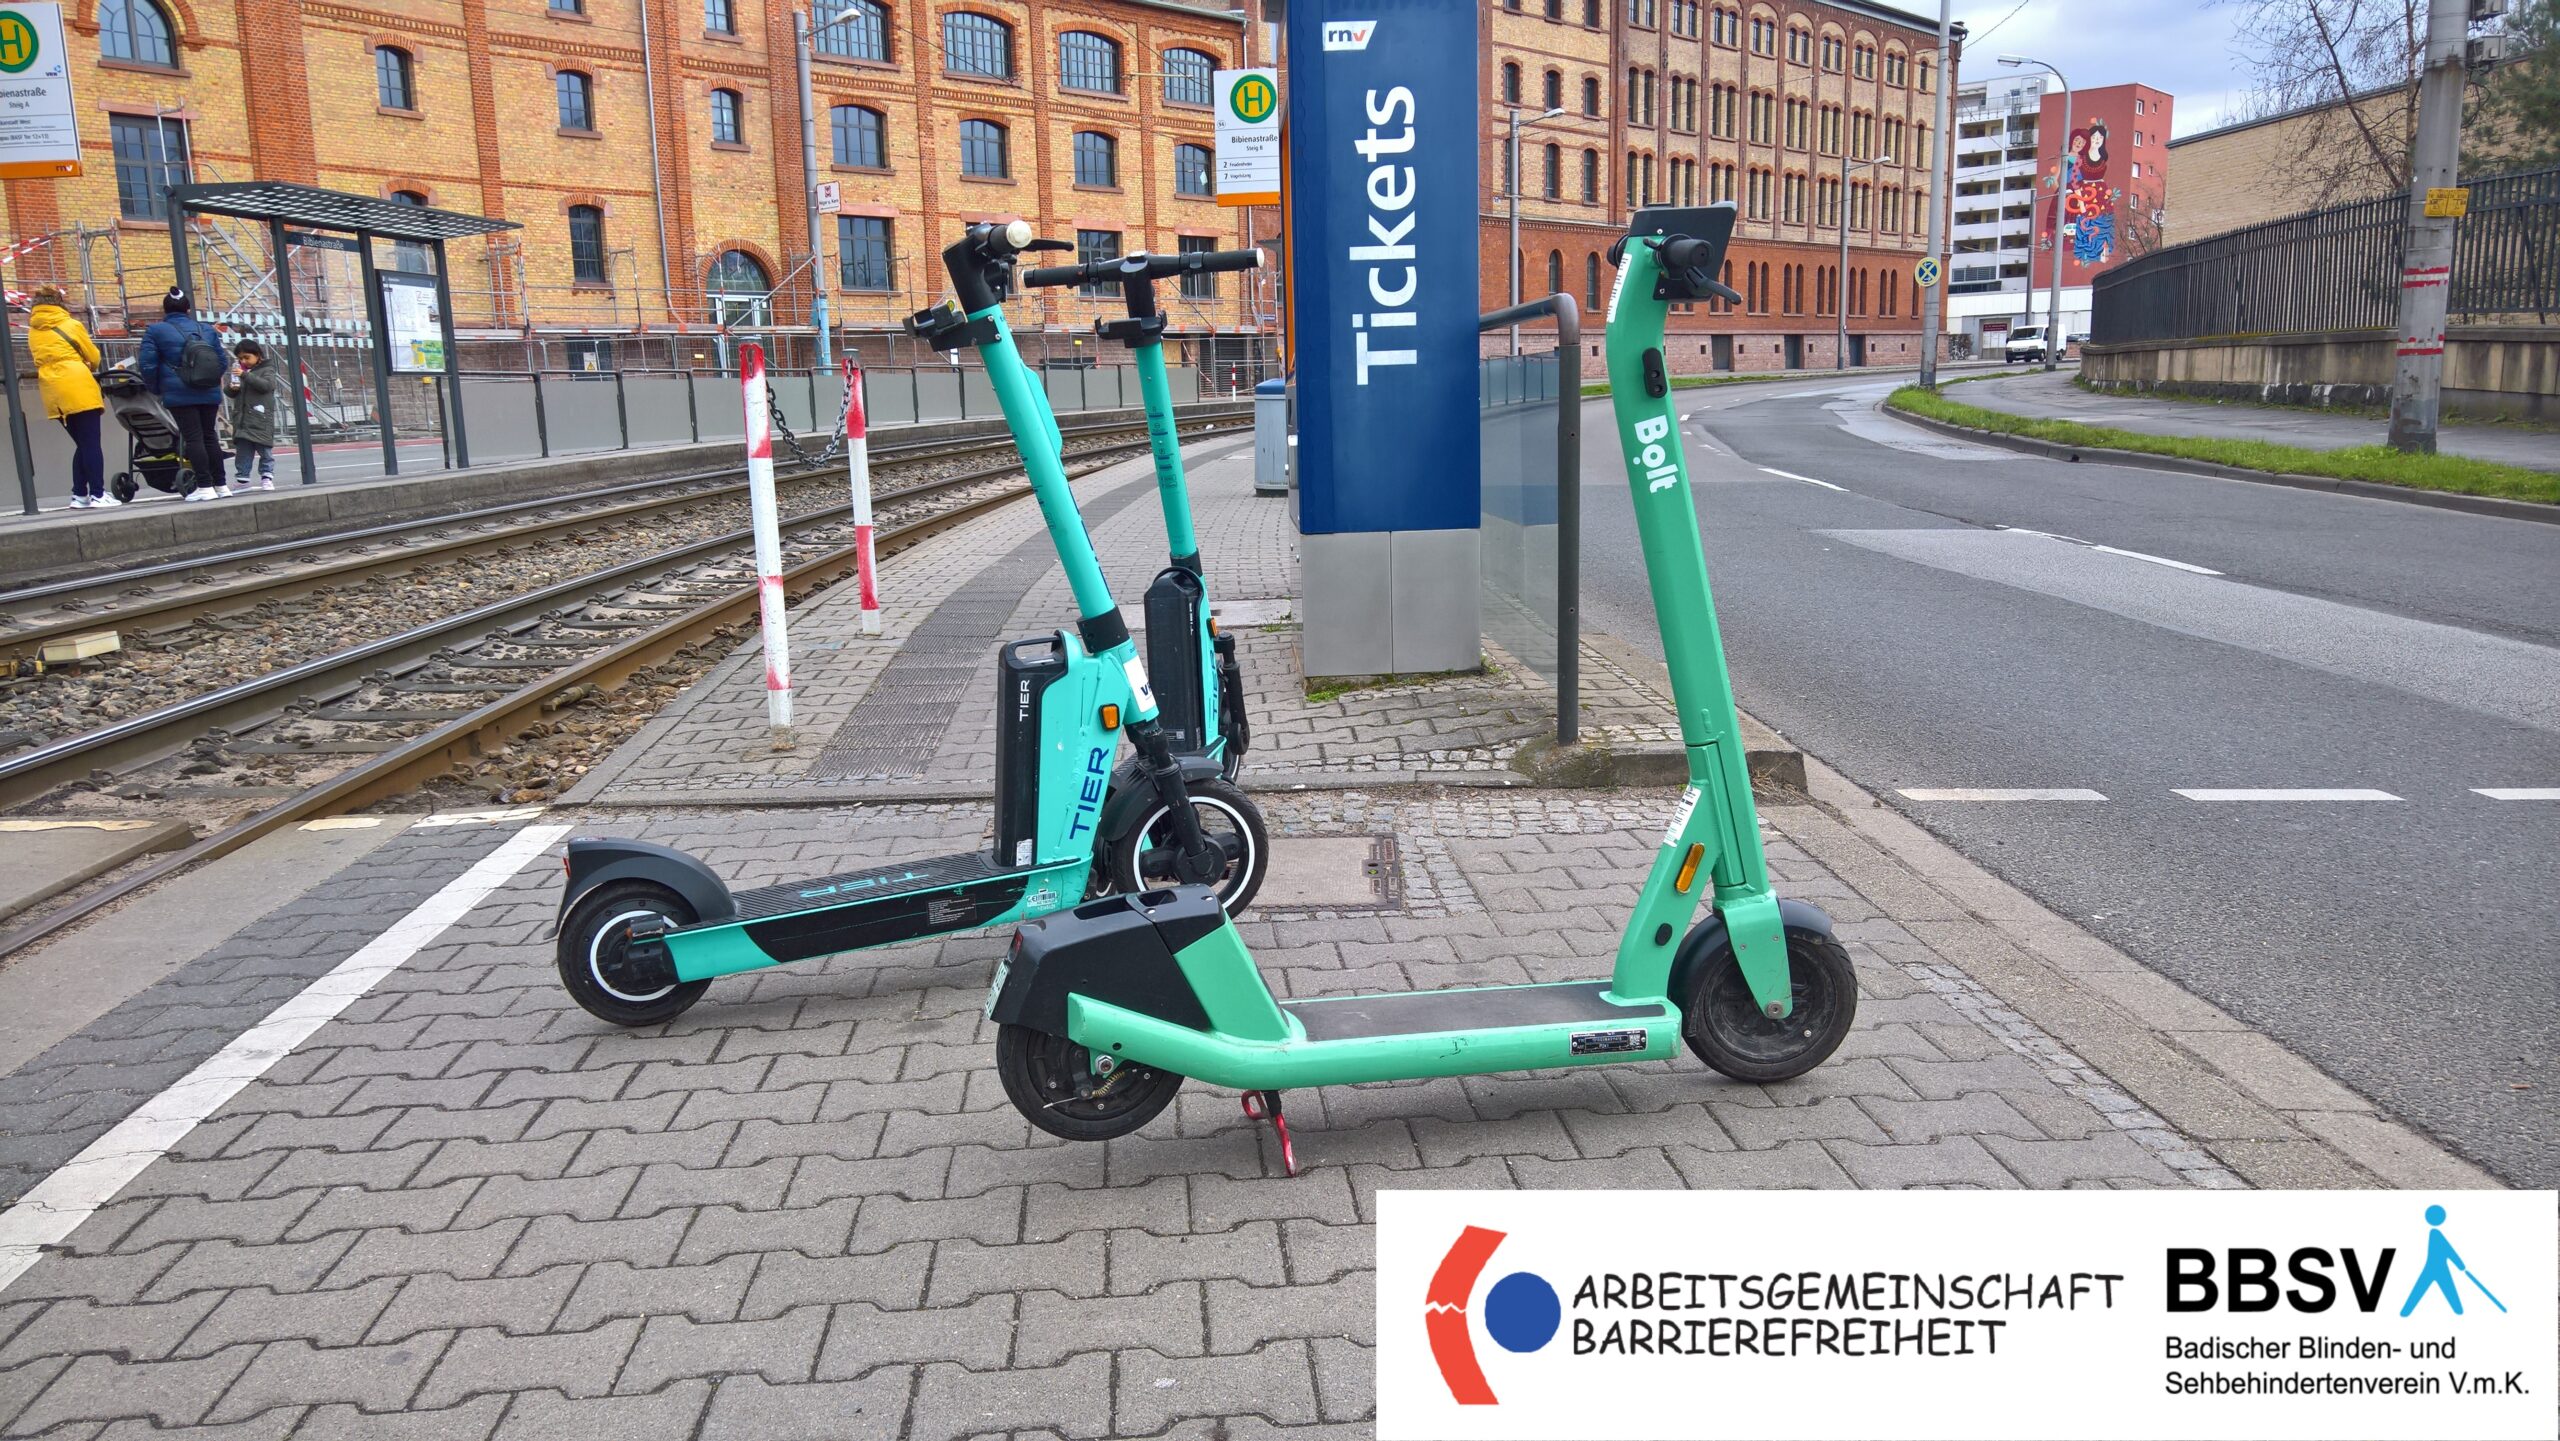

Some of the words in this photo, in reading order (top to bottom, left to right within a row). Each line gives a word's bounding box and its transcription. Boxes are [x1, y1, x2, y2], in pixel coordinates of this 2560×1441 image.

[1328, 28, 1368, 42] rnv
[9, 101, 24, 110] Steig
[1231, 134, 1278, 143] Bibienastraße
[303, 236, 344, 249] Bibienastraße
[1349, 85, 1418, 386] Tickets
[1633, 414, 1679, 494] Bolt
[1019, 679, 1031, 722] TIER
[1069, 747, 1110, 840] TIER
